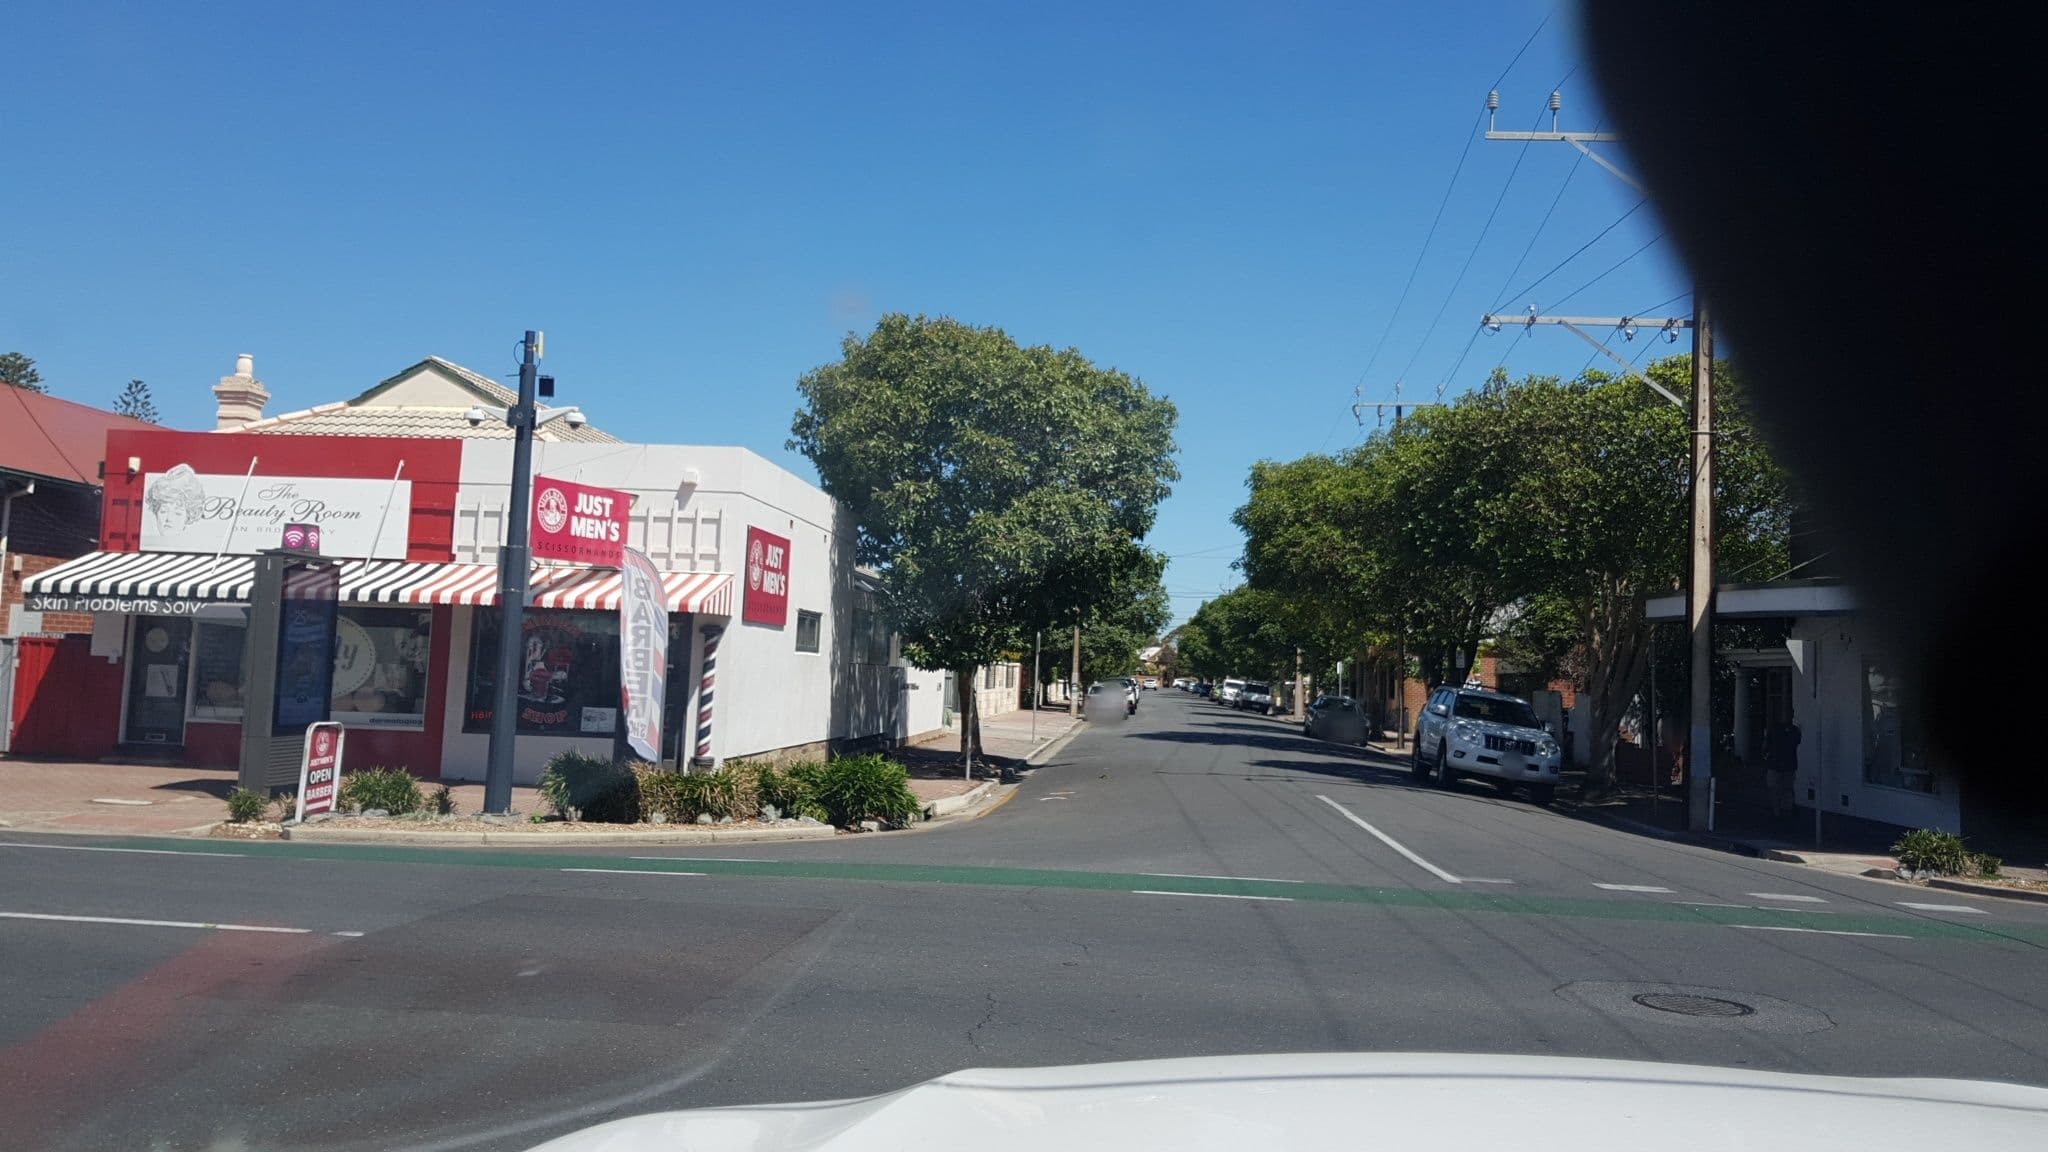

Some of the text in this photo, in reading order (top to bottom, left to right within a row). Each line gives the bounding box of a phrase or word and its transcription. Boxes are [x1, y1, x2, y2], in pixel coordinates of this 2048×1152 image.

[258, 483, 299, 500] The
[201, 496, 362, 525] Beauty Room
[575, 493, 613, 517] JUST
[570, 516, 620, 542] MEN'S
[537, 541, 622, 559] SCISSORHANDS
[765, 544, 784, 570] JUST
[762, 570, 785, 597] MEN'S
[32, 595, 68, 611] Skin
[162, 597, 207, 614] Solv
[310, 768, 332, 785] OPEN
